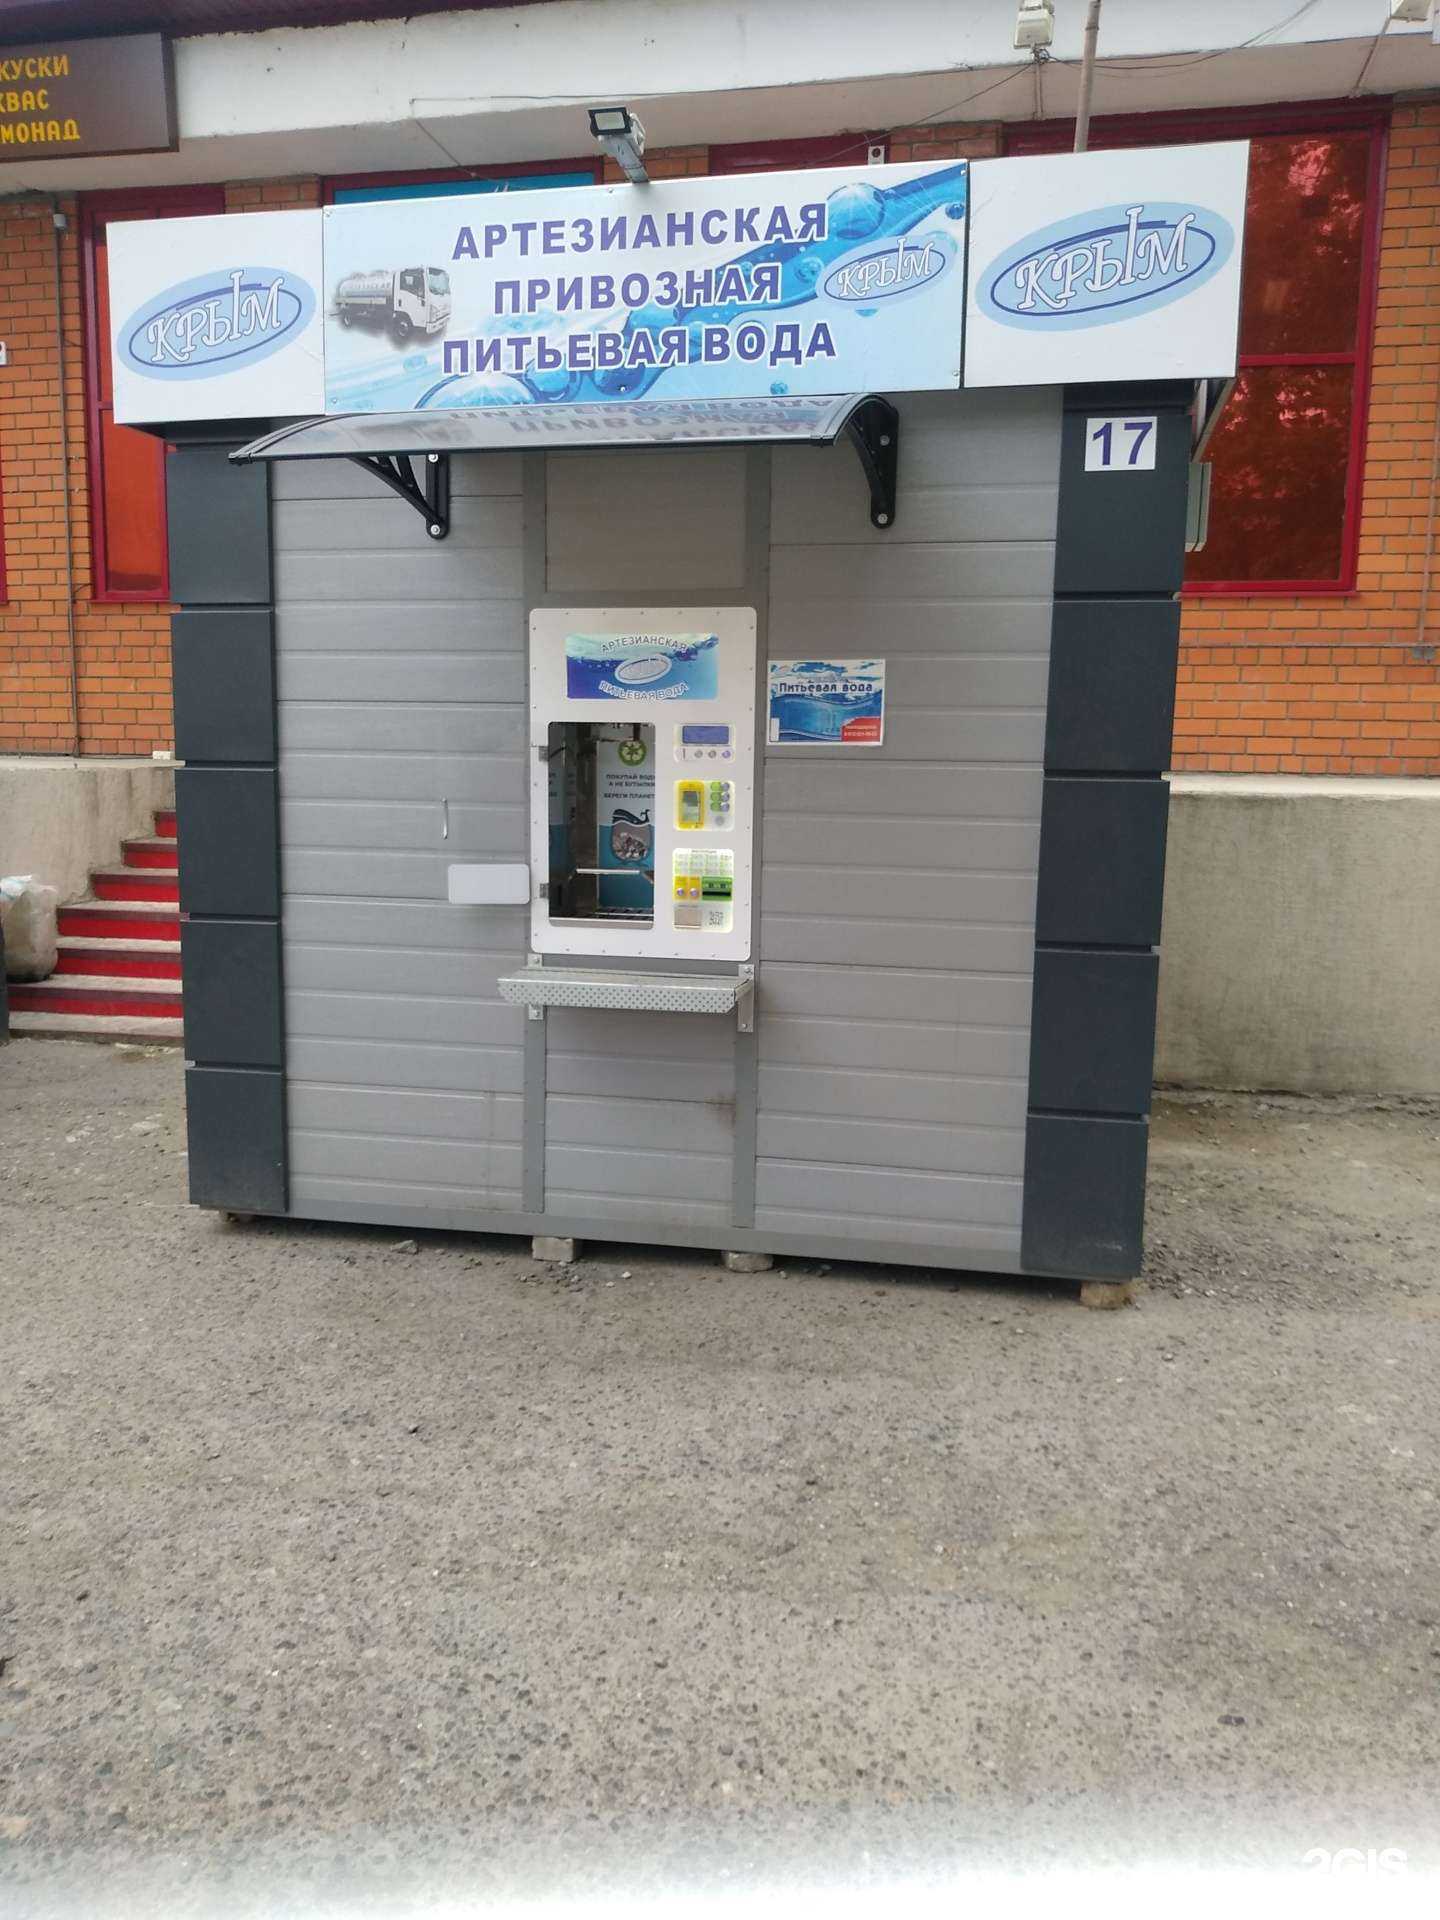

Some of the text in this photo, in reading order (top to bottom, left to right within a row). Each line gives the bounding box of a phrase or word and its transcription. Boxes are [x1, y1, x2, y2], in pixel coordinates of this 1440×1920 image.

[0, 54, 70, 81] КУСКИ
[0, 118, 81, 144] МОНАД
[451, 203, 828, 261] АРТЕЗИАНСКАЯ
[837, 238, 936, 298] КРЫМ
[1014, 204, 1196, 310] КРЫМ
[493, 263, 781, 315] ПРИВОЗНАЯ
[146, 269, 286, 363] КРЫМ
[443, 322, 837, 374] ПИТЬЕВАЯ ВОДА
[1091, 421, 1153, 466] 17
[601, 635, 688, 653] АРТЕЗИАНСКАЯ
[600, 680, 689, 700] ПИТЬЕВАЯ ВОДА
[779, 682, 873, 693] Питьевая вода
